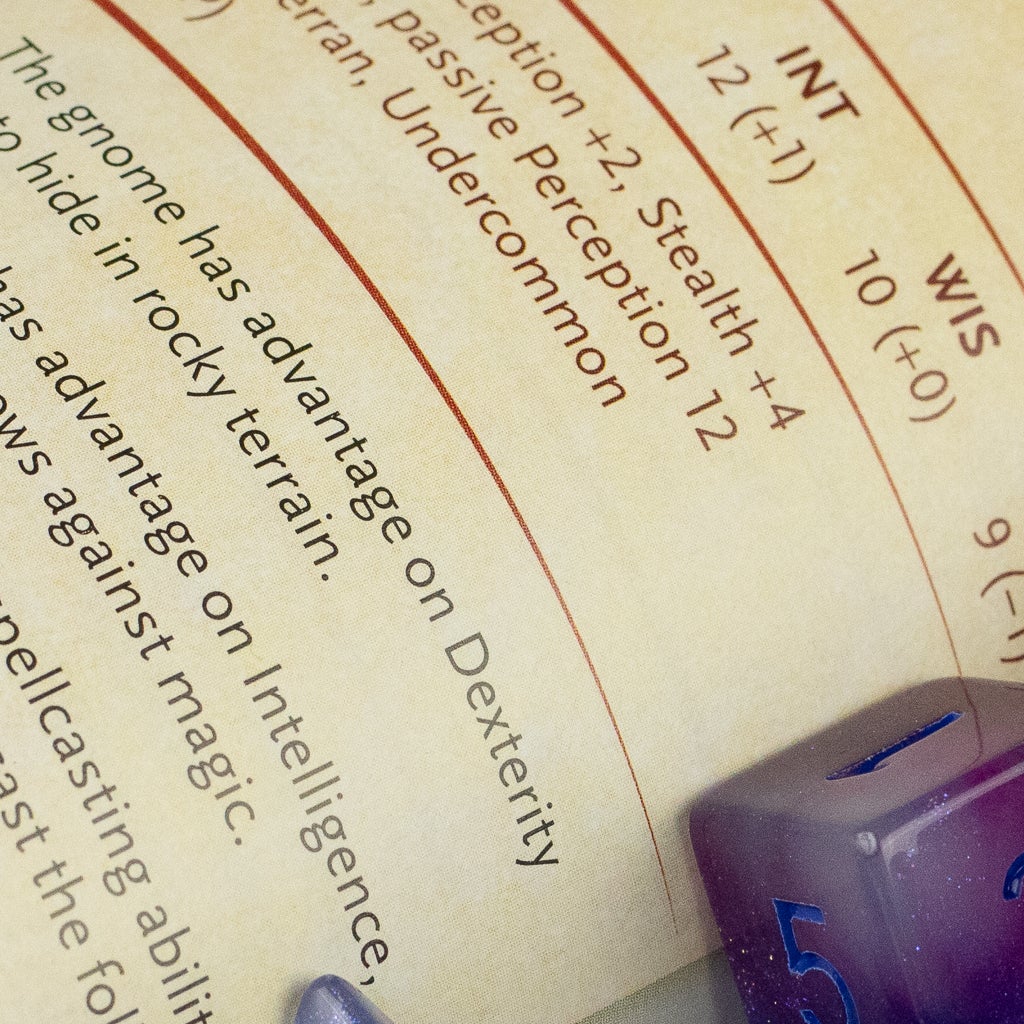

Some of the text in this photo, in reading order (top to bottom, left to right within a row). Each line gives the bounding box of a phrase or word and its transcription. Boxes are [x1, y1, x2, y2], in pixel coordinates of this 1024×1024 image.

[375, 11, 738, 451] passive Perception 12
[455, 0, 806, 430] eption +2, Stealth +4
[697, 44, 816, 184] 12 (+1)
[775, 45, 860, 122] INT
[17, 152, 101, 236] hide
[93, 236, 140, 281] in
[133, 288, 237, 398] rocky
[226, 407, 340, 582] terrain.
[382, 87, 627, 408] Undercommon
[844, 249, 956, 423] 10 (+0)
[926, 253, 1001, 358] WIS
[0, 36, 559, 868] The gnome has advantage on Dexterity
[973, 518, 1011, 549] 9
[0, 612, 151, 897] pellcasting
[36, 351, 208, 577] advantage
[202, 591, 253, 655] on
[243, 663, 389, 986] Intelligence,
[44, 487, 174, 661] against
[158, 671, 256, 846] magic.
[32, 860, 89, 950] the
